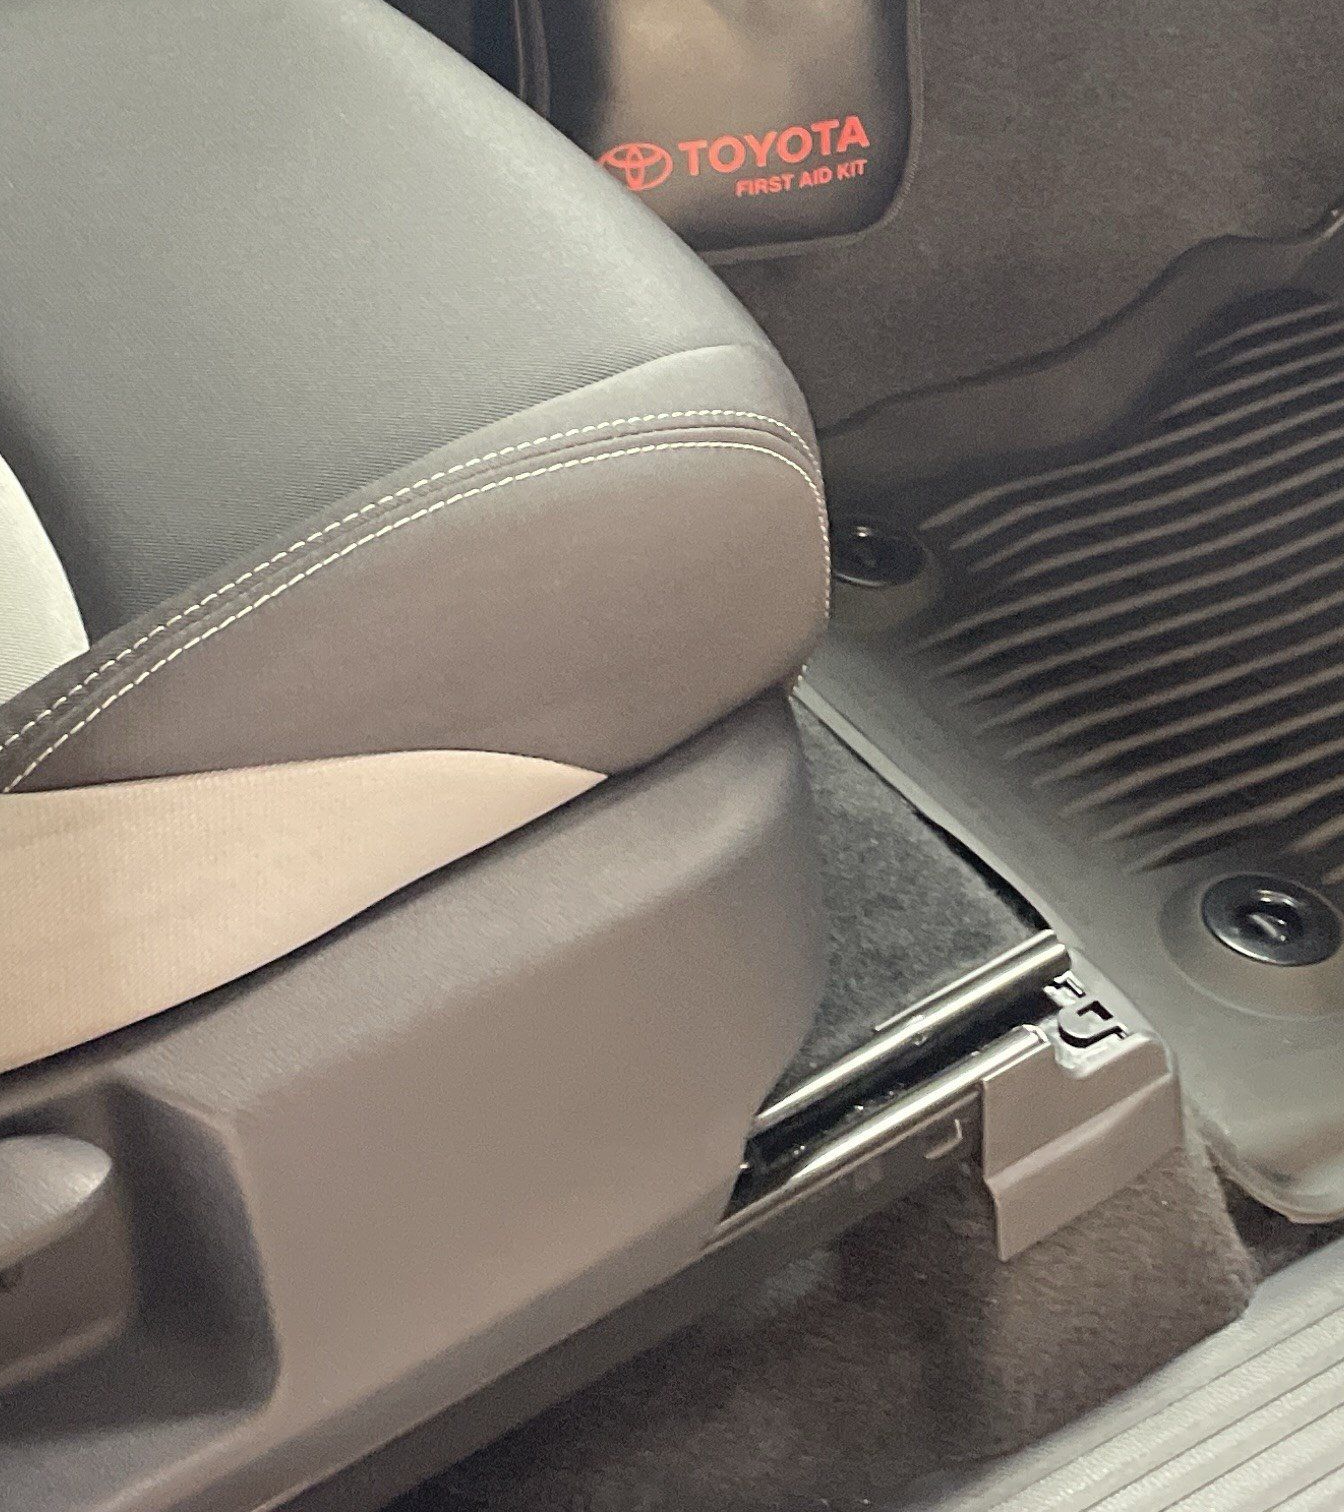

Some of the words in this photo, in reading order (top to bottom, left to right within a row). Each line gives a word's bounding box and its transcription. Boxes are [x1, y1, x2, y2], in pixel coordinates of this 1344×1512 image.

[678, 114, 871, 177] TOYOTA
[734, 173, 795, 197] FIRST
[798, 165, 833, 188] AID
[836, 158, 868, 180] KIT
